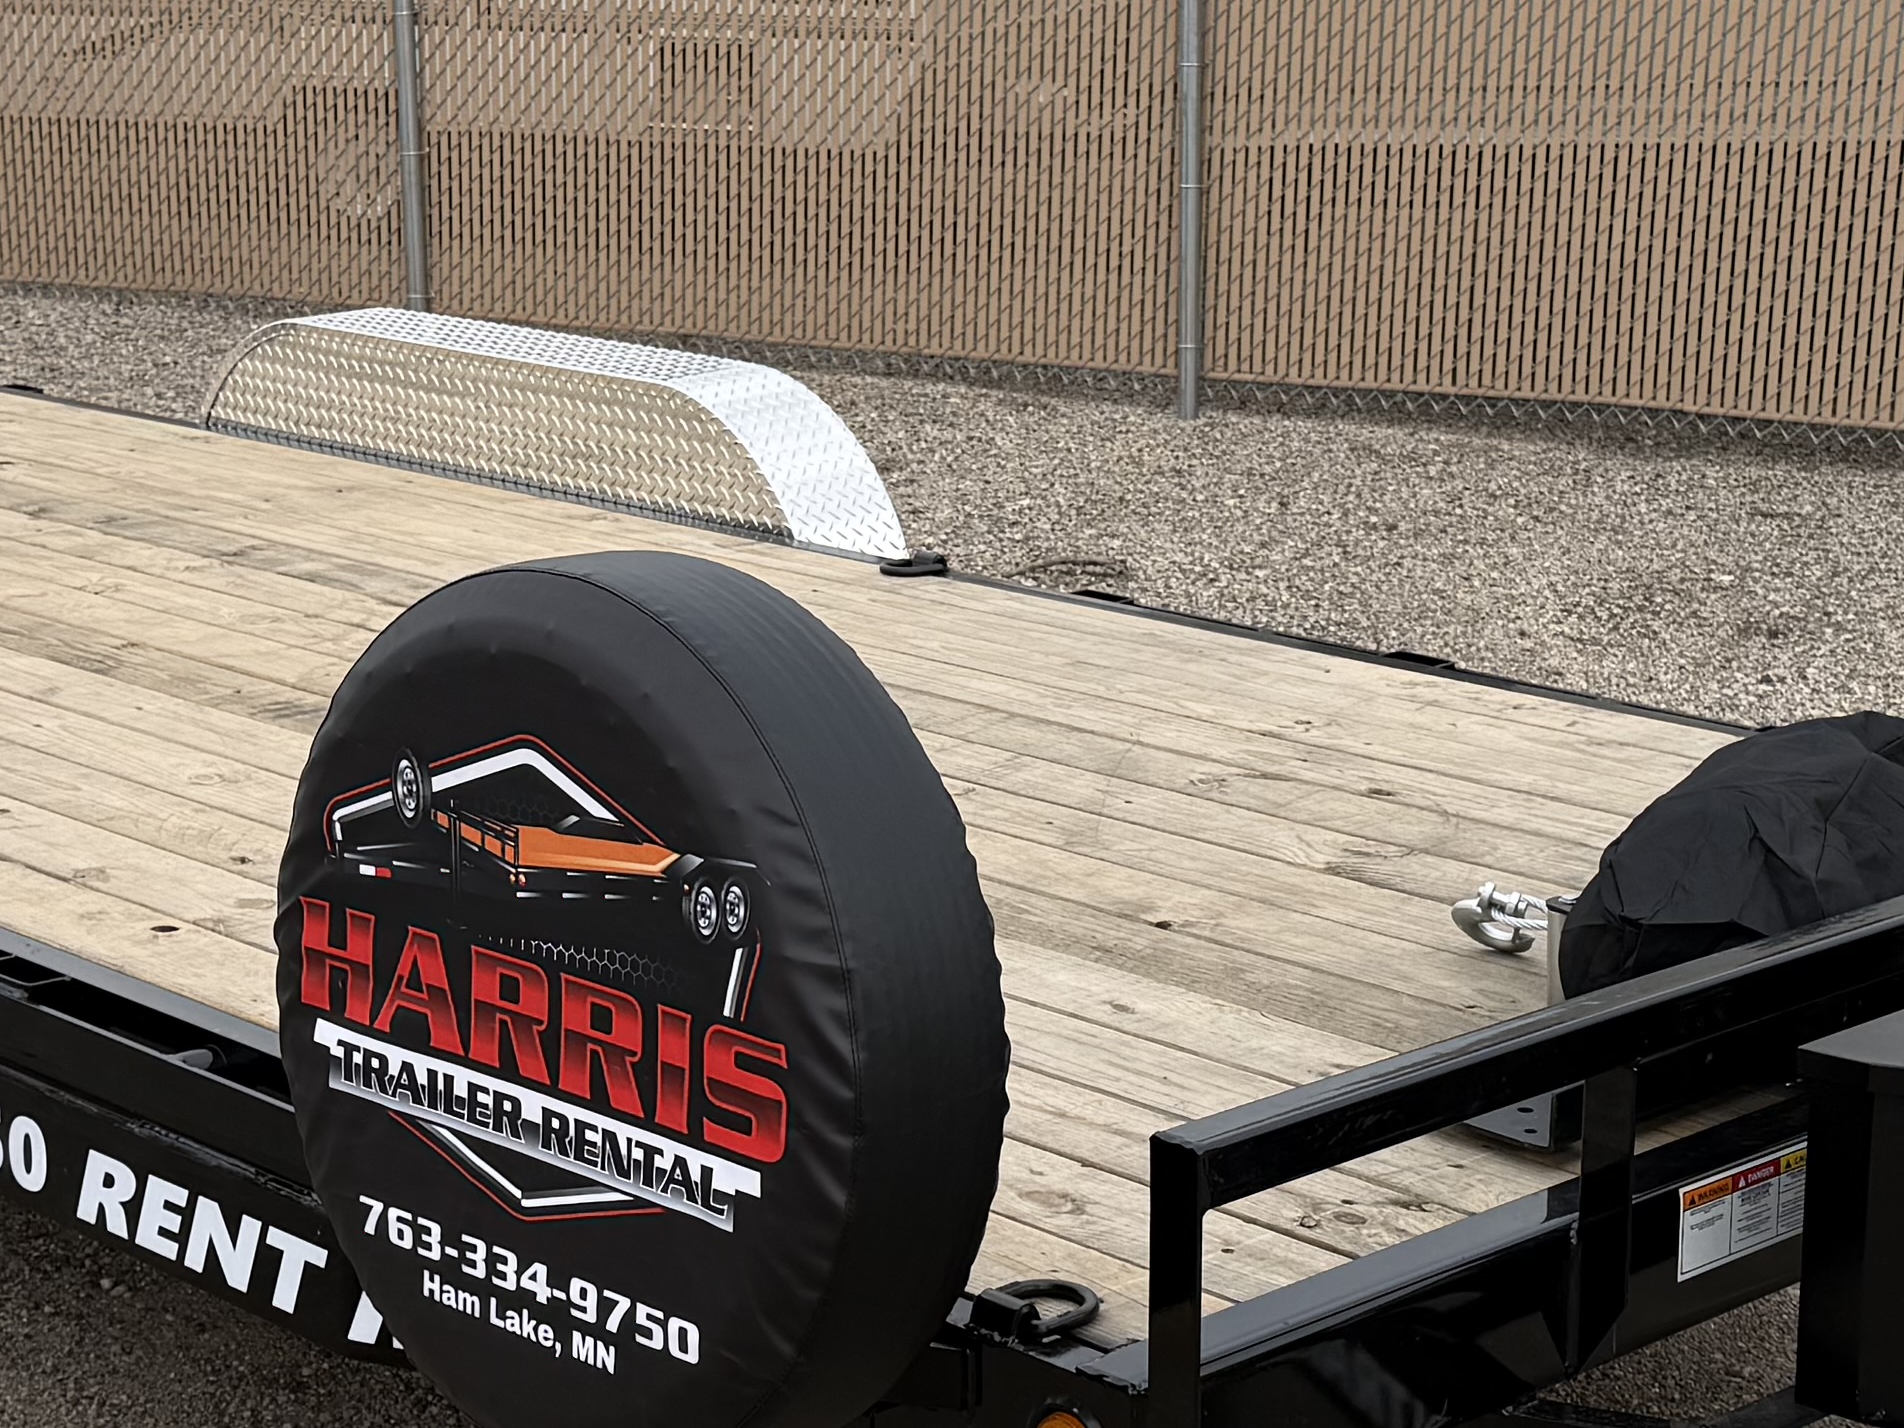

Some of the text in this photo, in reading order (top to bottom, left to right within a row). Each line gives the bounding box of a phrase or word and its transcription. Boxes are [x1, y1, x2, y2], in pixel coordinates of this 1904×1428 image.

[301, 898, 788, 1163] HARRIS
[336, 1039, 729, 1216] TRAILER RENTAL
[77, 1150, 328, 1313] RENT
[360, 1195, 699, 1364] 763-334-9750
[424, 1269, 481, 1318] Ham
[489, 1296, 562, 1358] Lake,
[572, 1330, 616, 1375] MN
